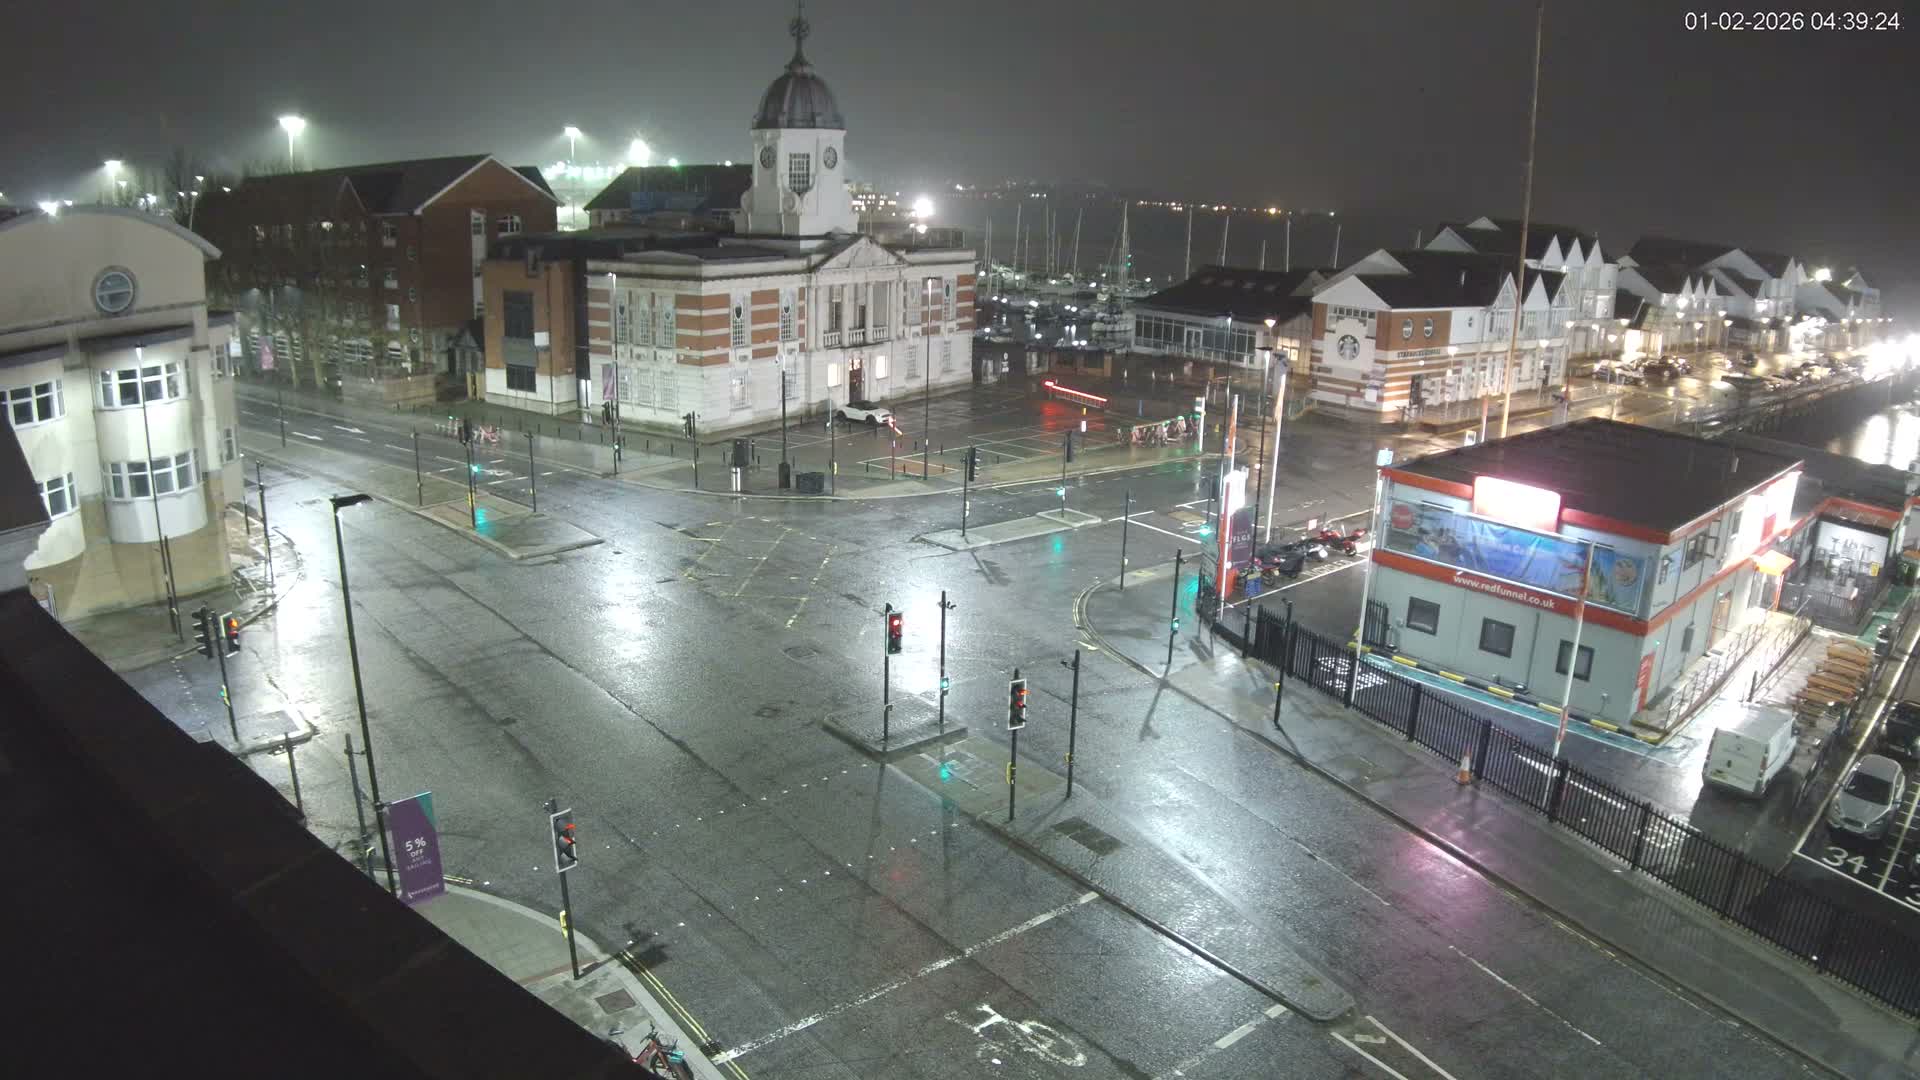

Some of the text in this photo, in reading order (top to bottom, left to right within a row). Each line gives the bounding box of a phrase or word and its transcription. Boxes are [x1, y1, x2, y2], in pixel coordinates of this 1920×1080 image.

[1452, 575, 1555, 609] www.redfunnel.co.uk
[410, 849, 424, 858] OFF
[1821, 846, 1868, 875] 34
